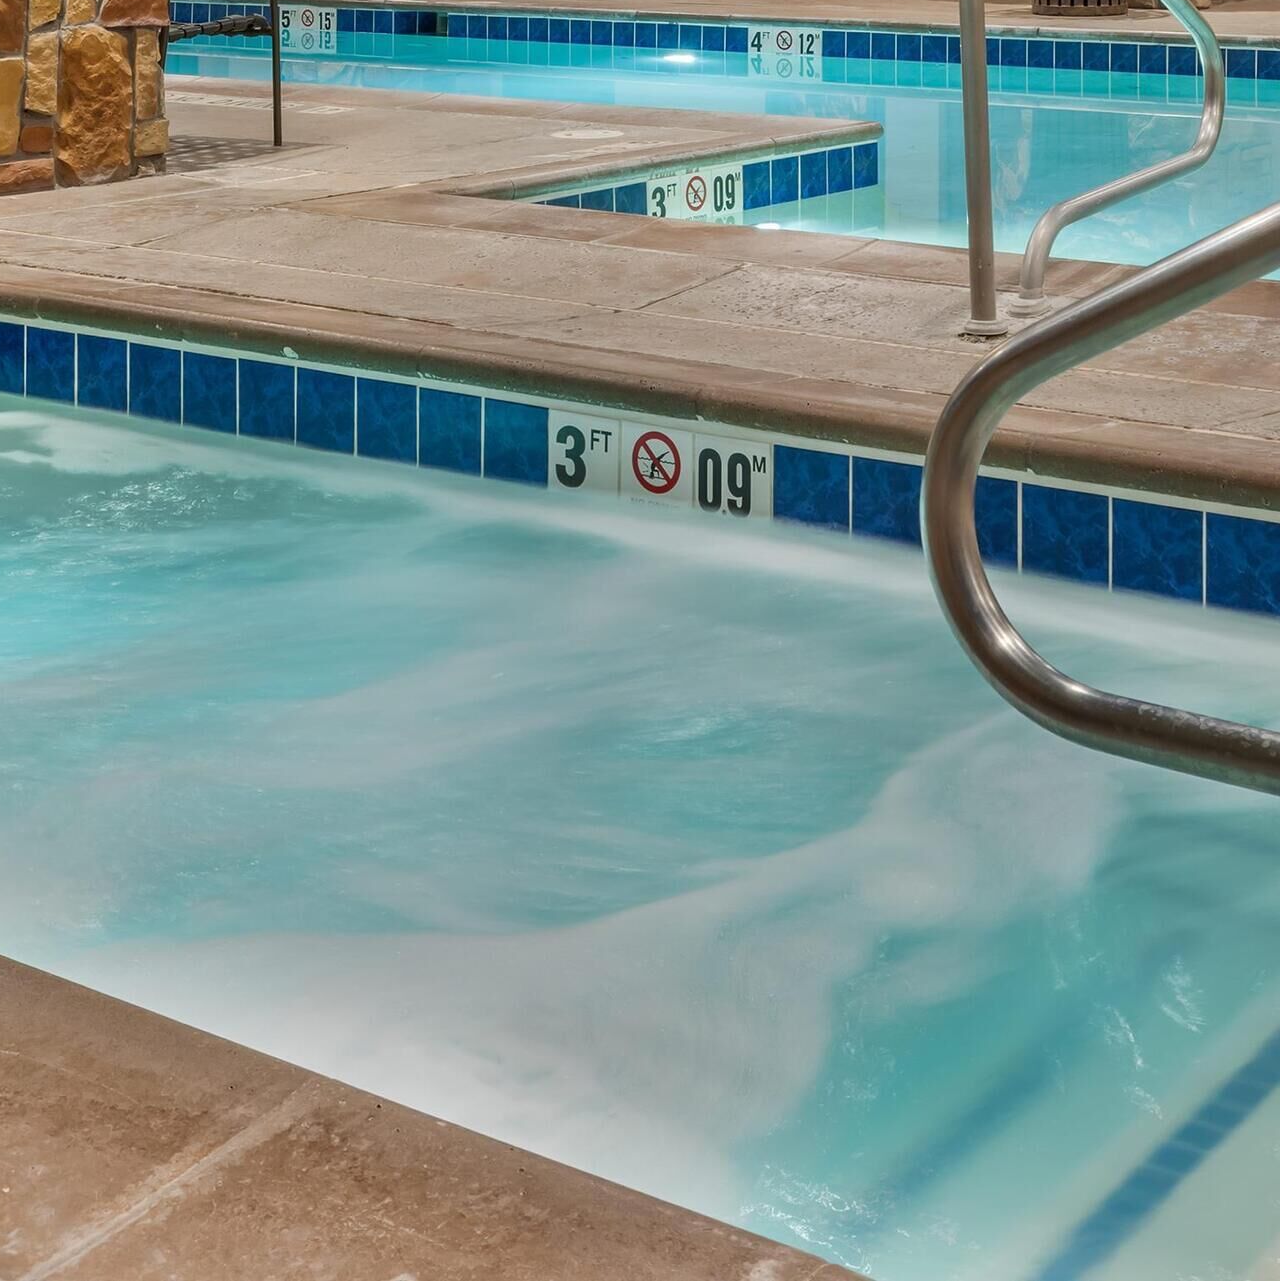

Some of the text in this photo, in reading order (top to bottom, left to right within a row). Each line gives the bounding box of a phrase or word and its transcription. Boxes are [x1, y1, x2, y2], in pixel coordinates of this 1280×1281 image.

[282, 10, 290, 28] 5
[750, 32, 762, 52] 4
[652, 186, 666, 218] 3
[667, 183, 677, 198] FT
[555, 425, 587, 488] 3
[590, 428, 612, 453] FT
[752, 455, 767, 474] M
